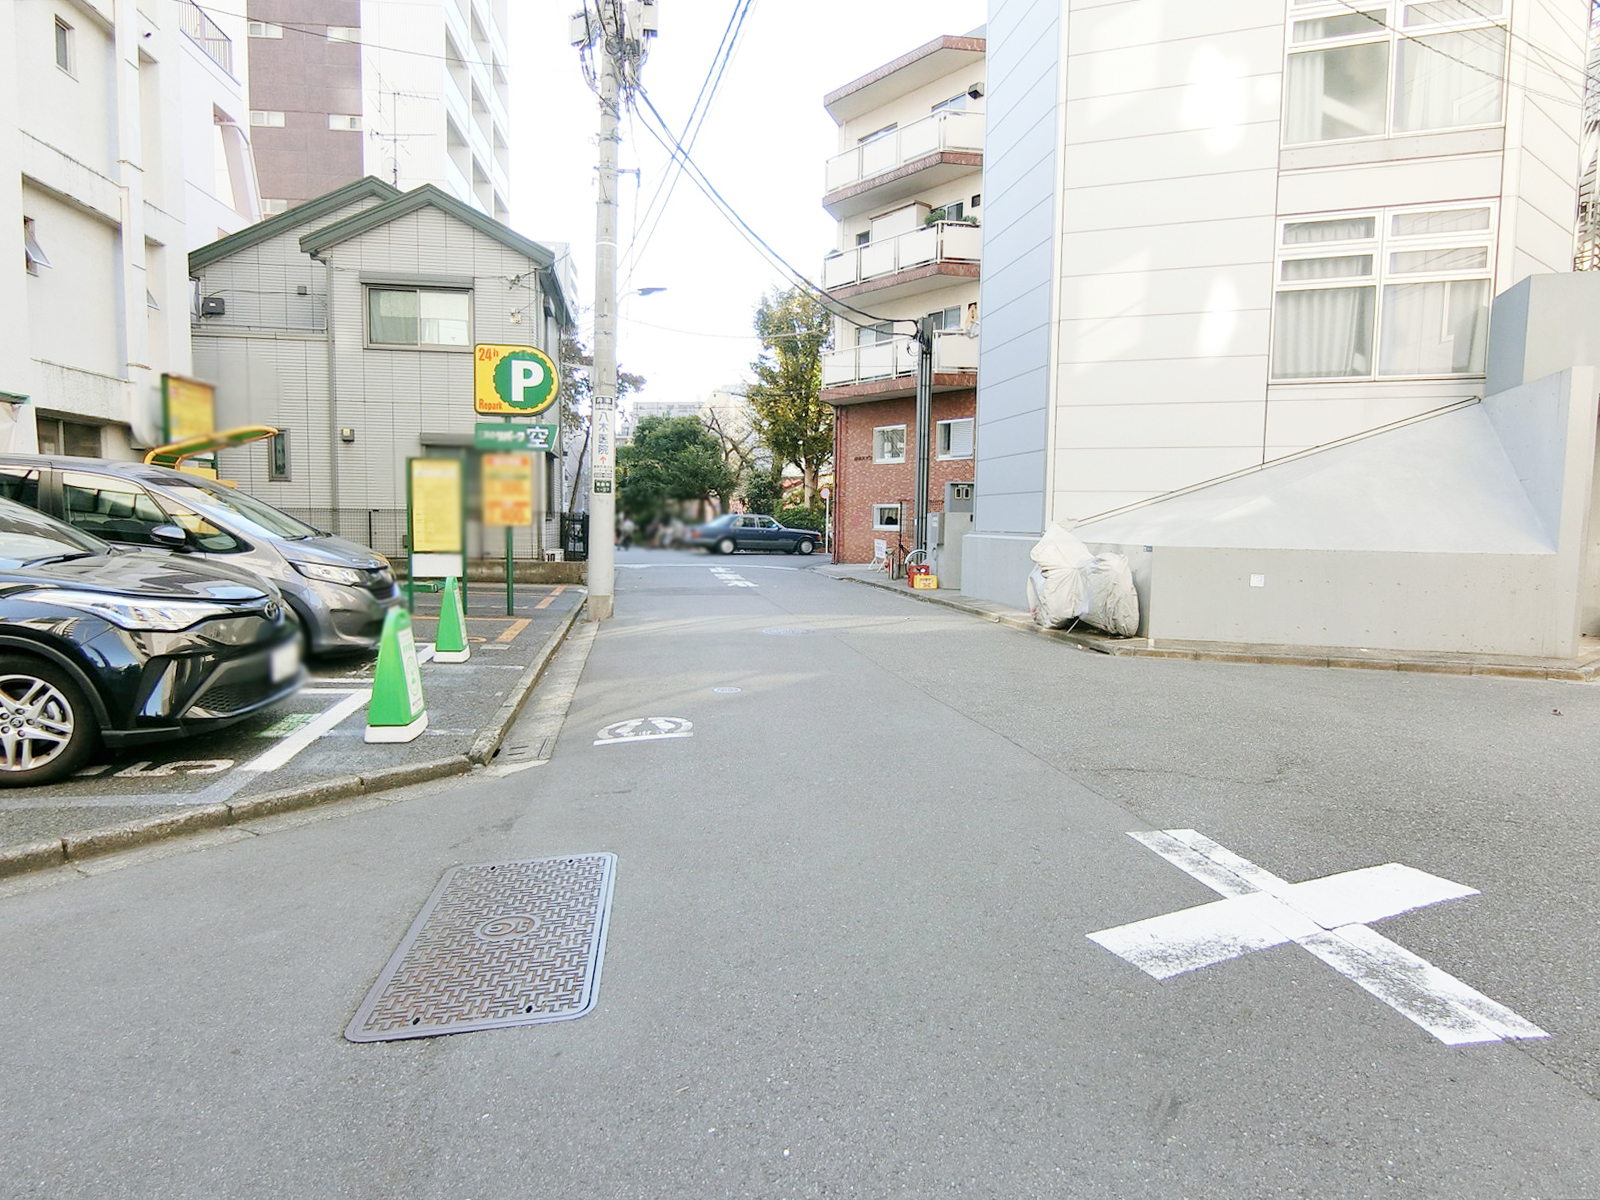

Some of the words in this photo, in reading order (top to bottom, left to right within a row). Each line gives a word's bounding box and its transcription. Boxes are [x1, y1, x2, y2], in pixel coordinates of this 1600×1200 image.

[511, 359, 545, 402] P
[478, 398, 503, 411] Repark
[526, 425, 549, 448] 空
[597, 411, 609, 455] 八木医院
